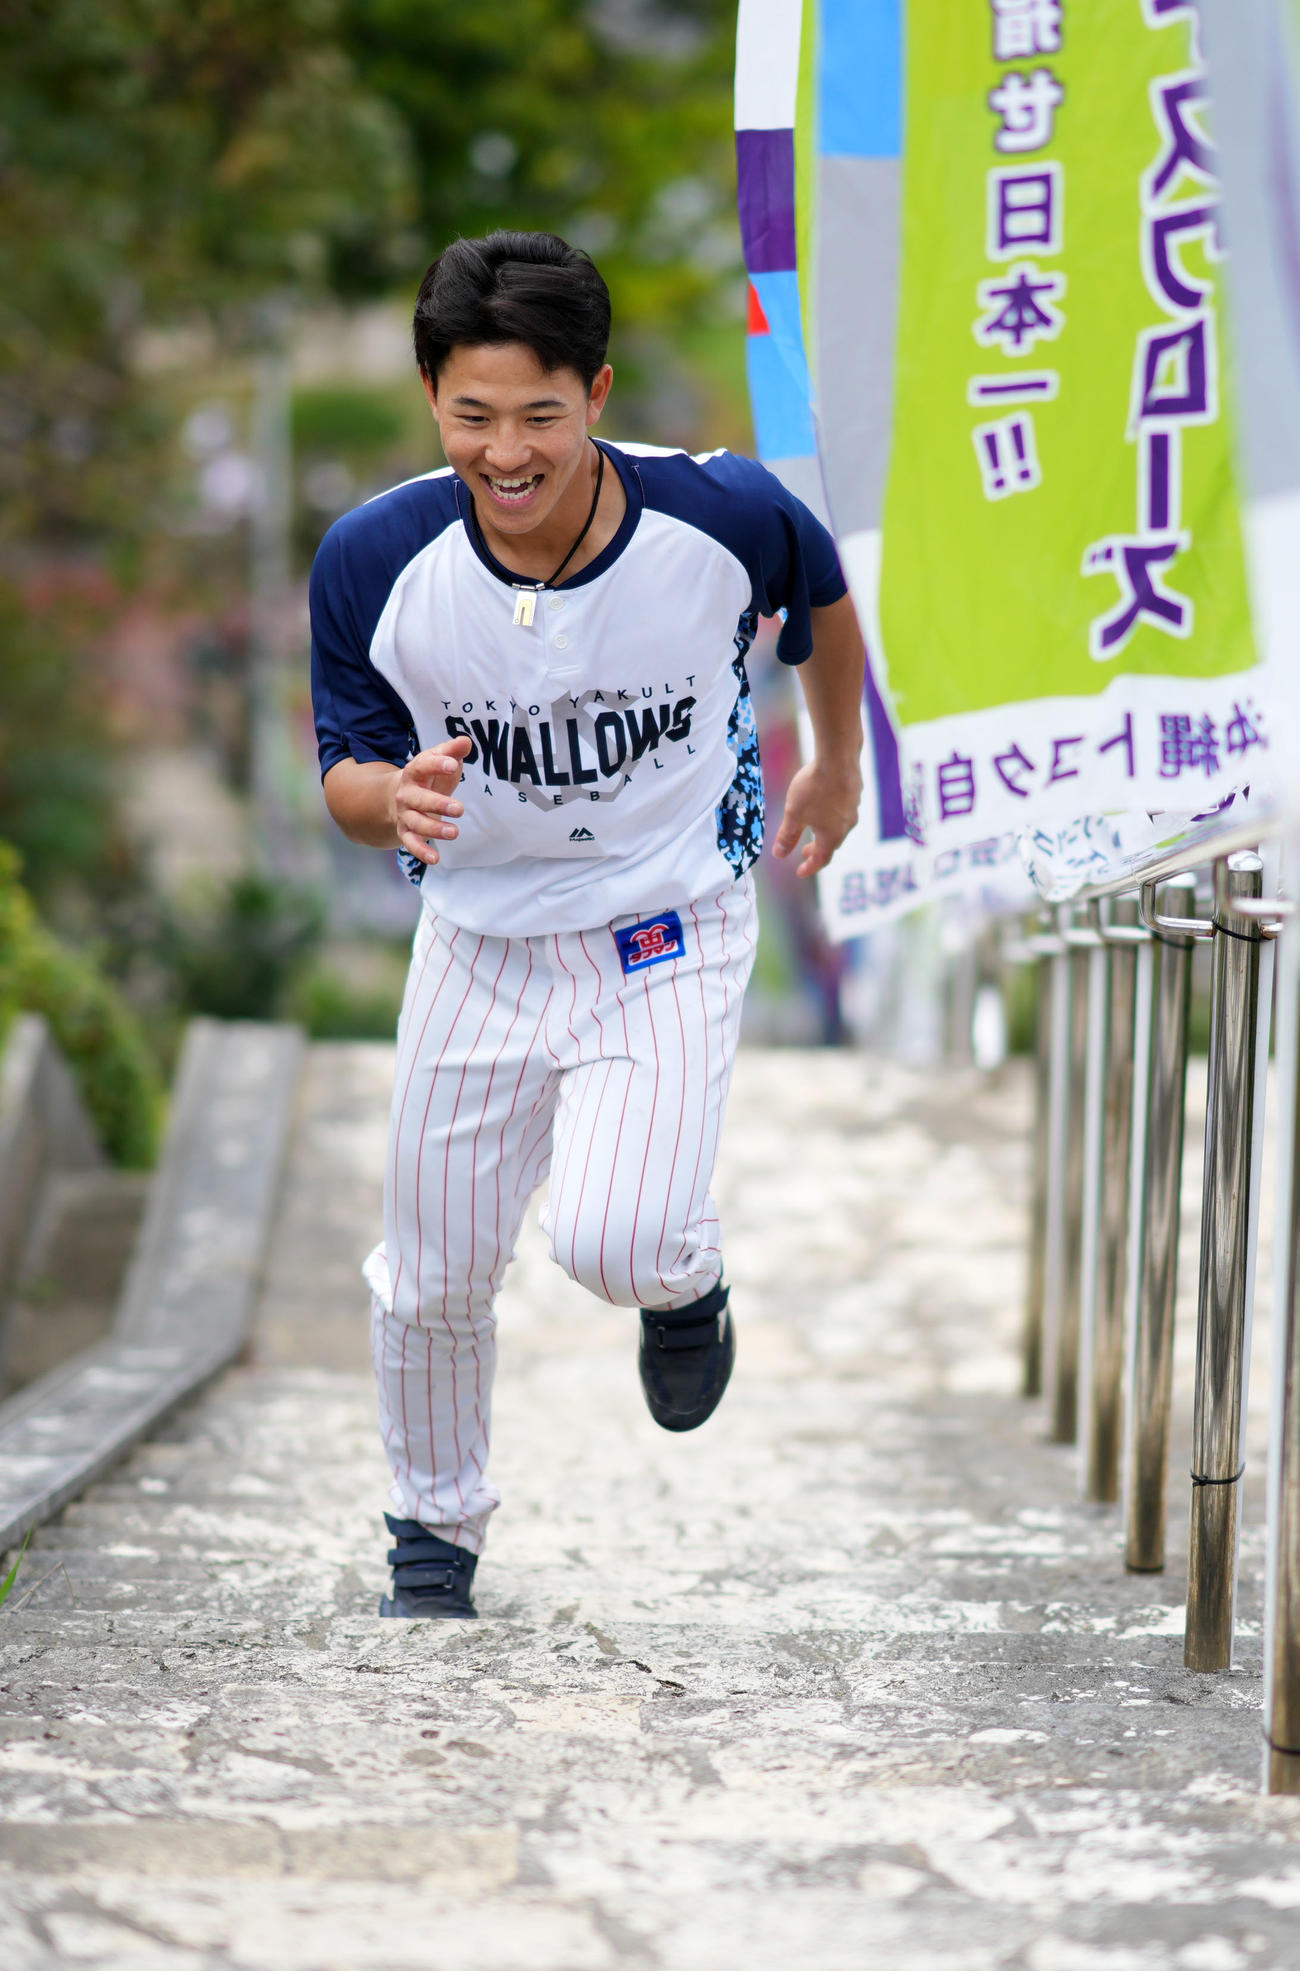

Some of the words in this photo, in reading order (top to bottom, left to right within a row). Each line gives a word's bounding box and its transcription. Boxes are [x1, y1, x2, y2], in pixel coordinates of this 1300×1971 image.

[441, 700, 540, 716] TOKYO
[569, 675, 696, 709] YAKULT
[444, 695, 697, 787] SWALLOWS
[458, 744, 696, 806] BASEBALL
